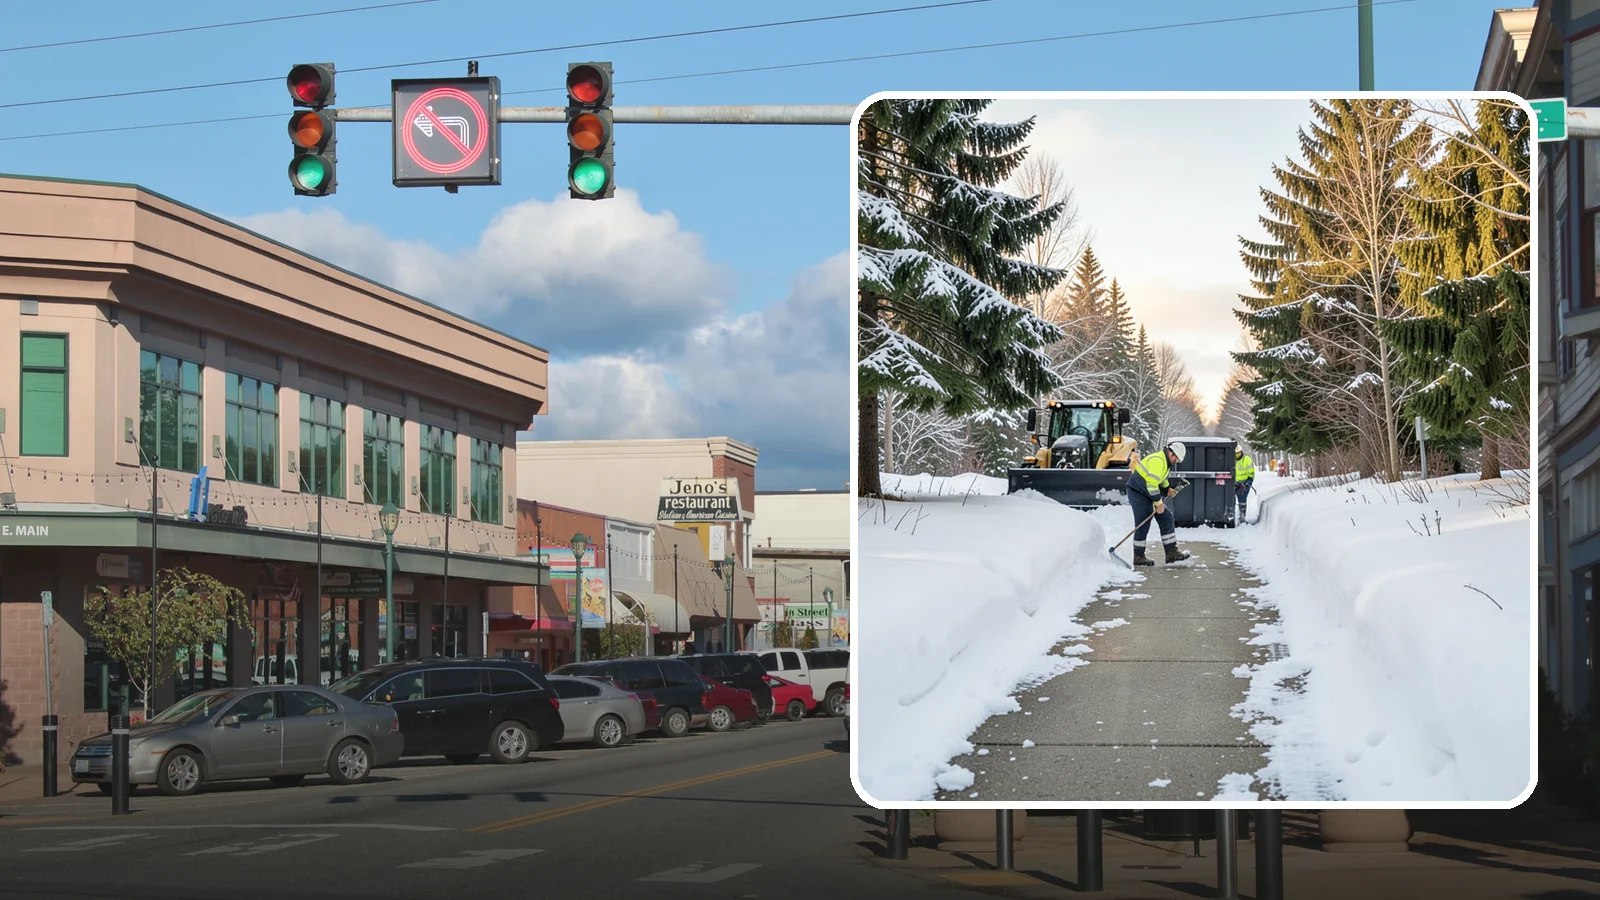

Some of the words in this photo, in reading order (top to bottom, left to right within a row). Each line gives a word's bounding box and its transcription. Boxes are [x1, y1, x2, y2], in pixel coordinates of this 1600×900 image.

[670, 480, 728, 494] Jeno's
[665, 496, 731, 509] restaurant
[658, 510, 681, 519] Italian
[686, 510, 714, 519] American
[715, 509, 737, 519] Cuisine
[2, 525, 13, 536] E.
[15, 525, 49, 536] MAIN
[786, 607, 794, 616] in
[797, 607, 828, 616] Street
[791, 619, 823, 627] lass
